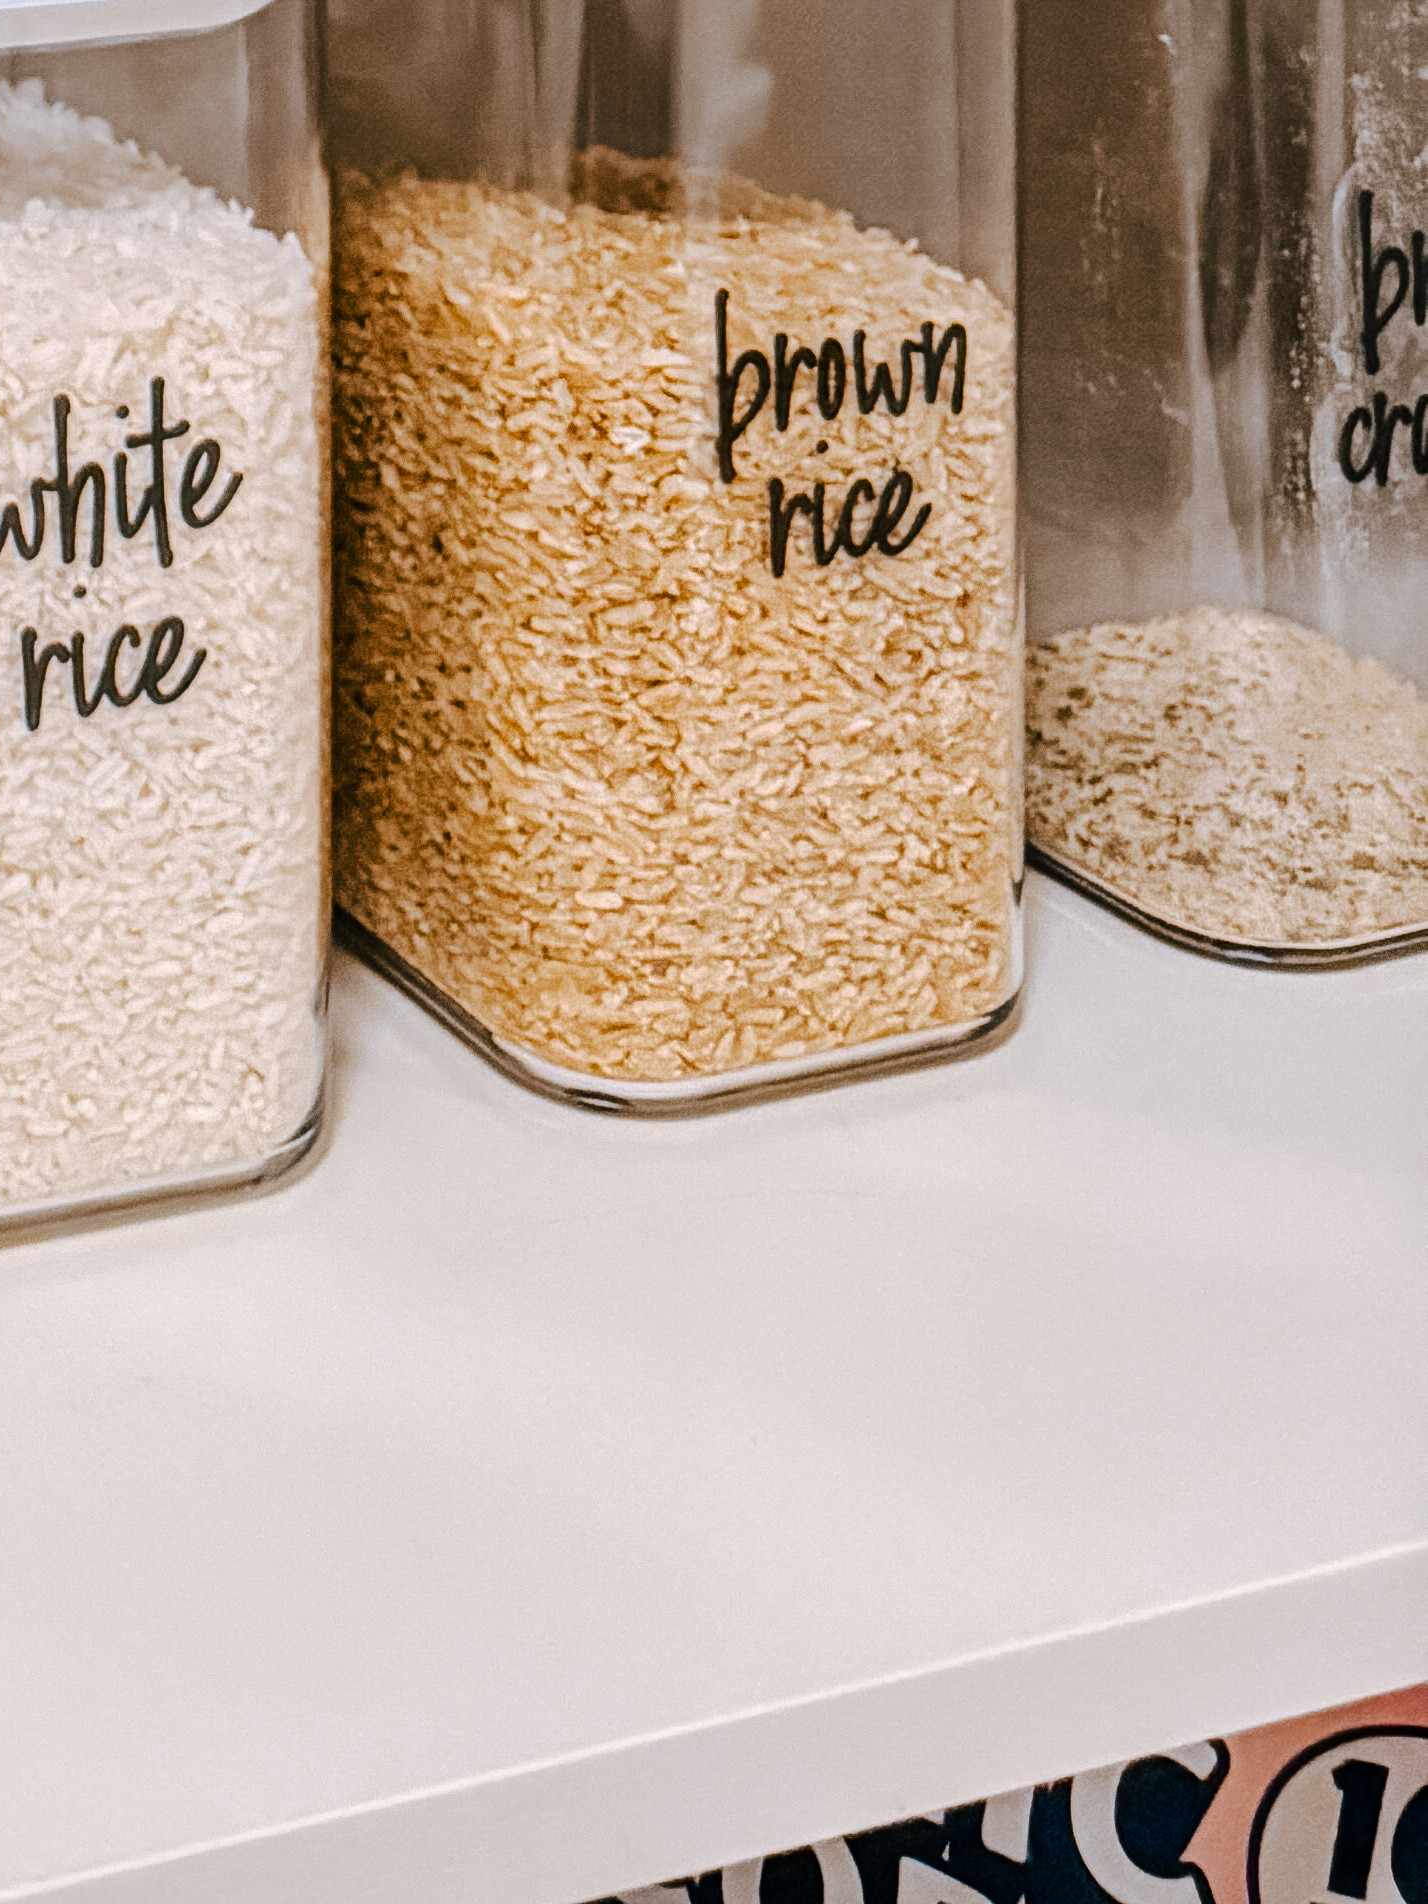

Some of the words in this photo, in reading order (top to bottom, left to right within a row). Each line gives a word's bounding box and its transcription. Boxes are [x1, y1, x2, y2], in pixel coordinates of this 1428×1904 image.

[715, 288, 967, 484] brown
[767, 440, 932, 578] rice
[21, 585, 207, 731] rice
